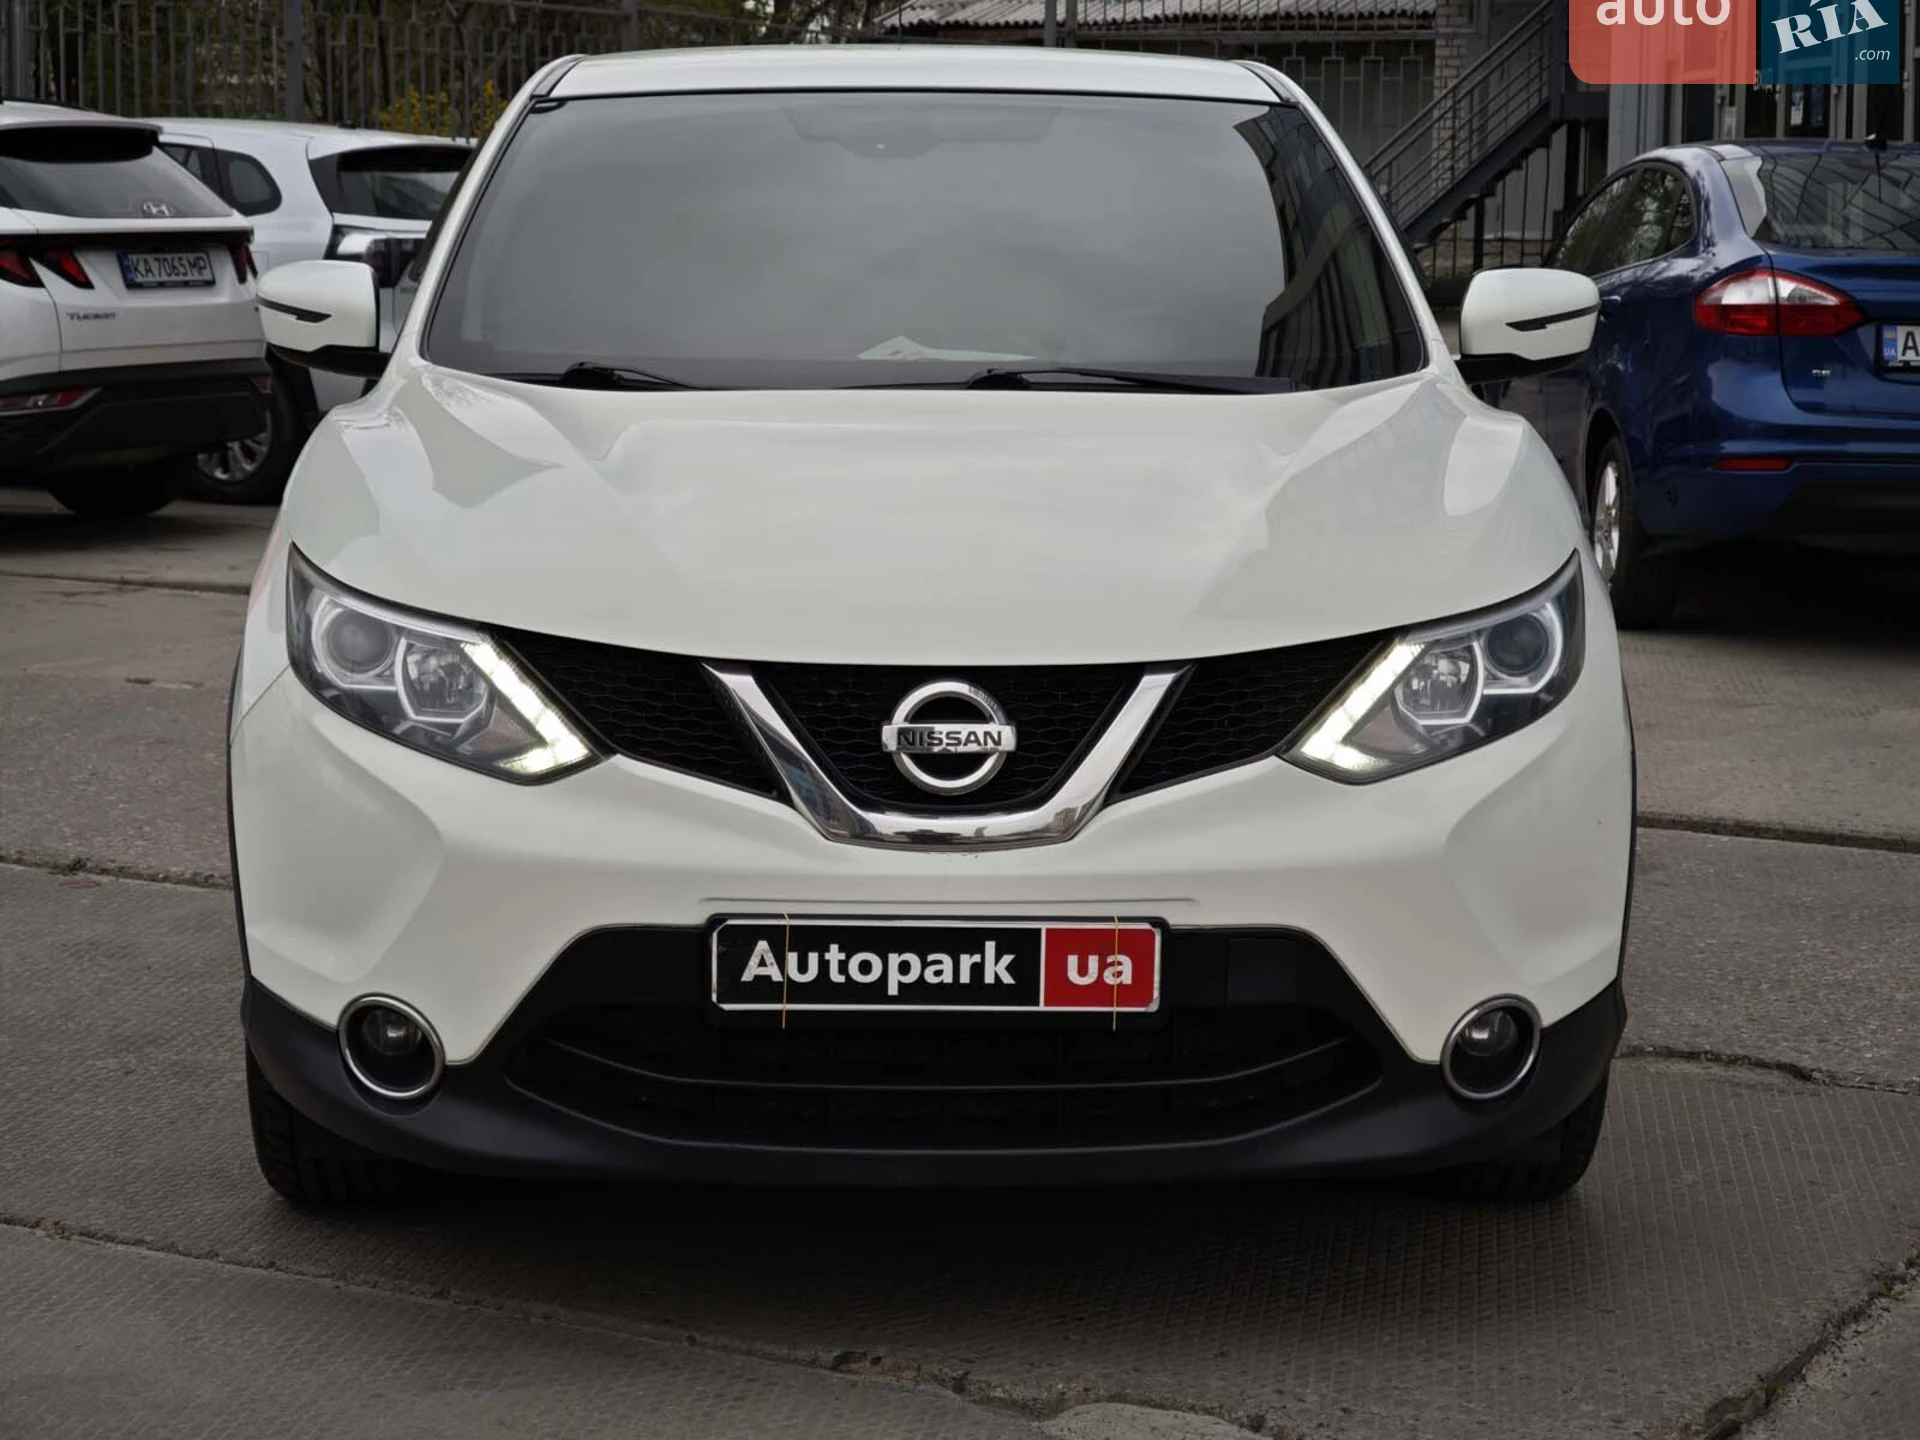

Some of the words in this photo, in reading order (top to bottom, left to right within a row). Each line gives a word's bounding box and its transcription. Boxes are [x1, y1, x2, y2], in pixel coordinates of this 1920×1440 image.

[897, 730, 1002, 747] NISSAN
[741, 940, 1016, 995] Autopark
[1067, 954, 1132, 985] ua
